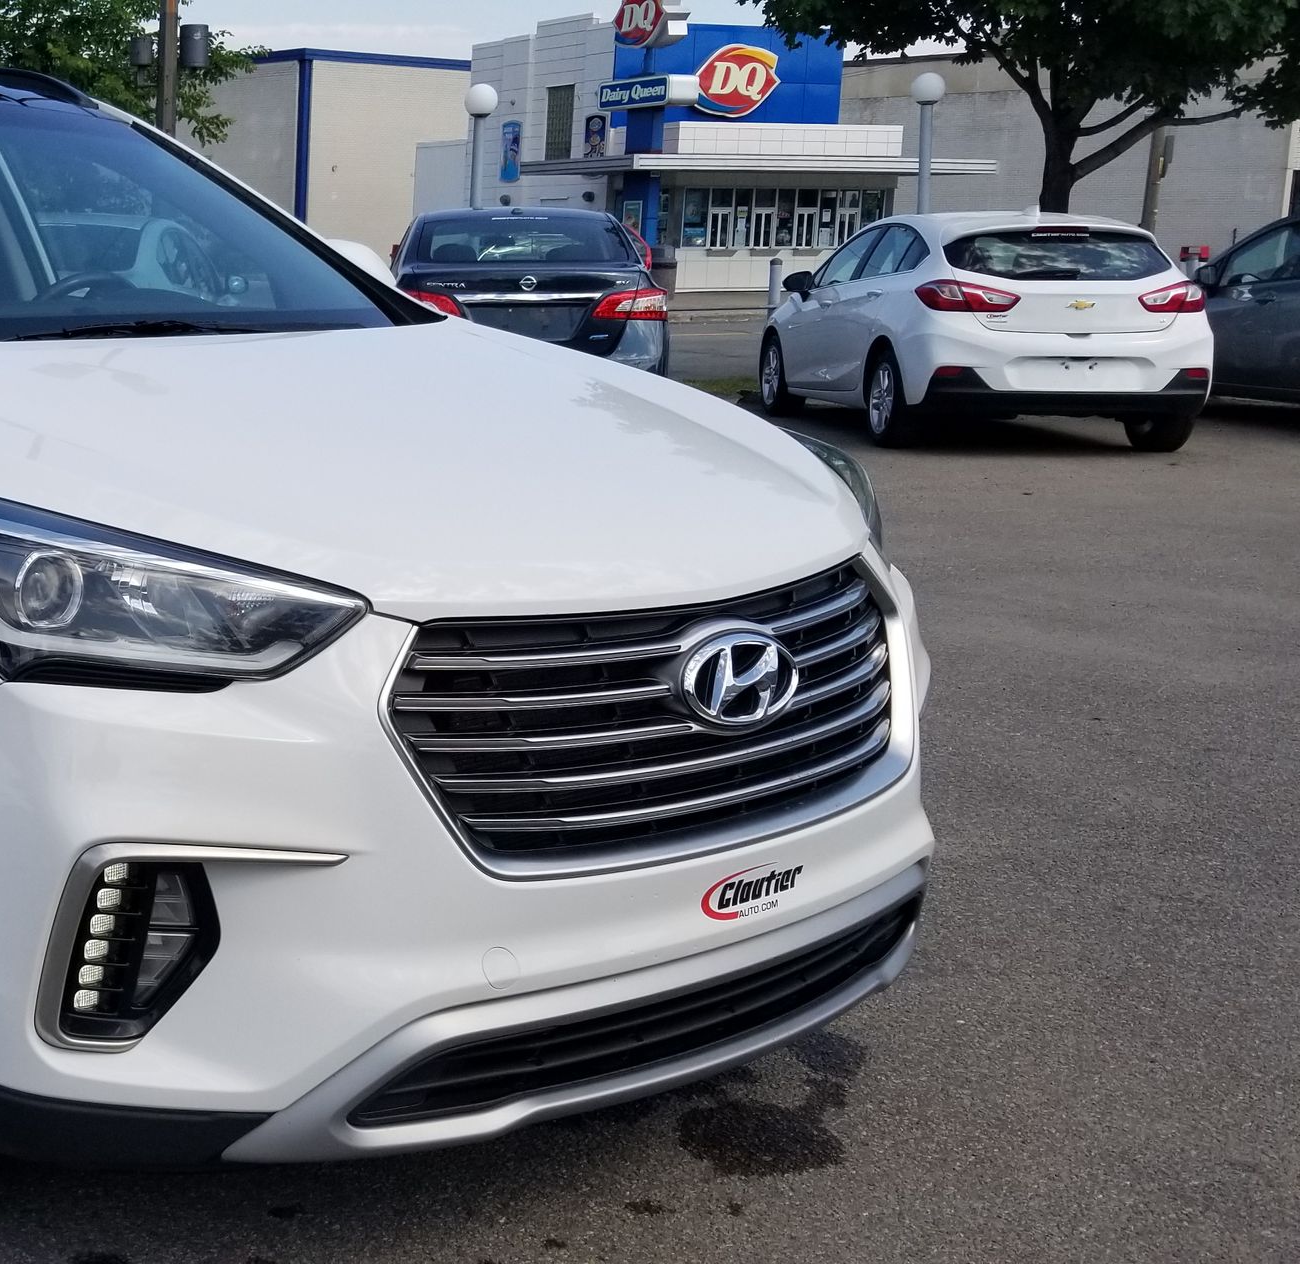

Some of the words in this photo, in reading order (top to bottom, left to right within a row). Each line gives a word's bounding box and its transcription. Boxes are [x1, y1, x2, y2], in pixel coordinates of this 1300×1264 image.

[621, 0, 656, 32] DQ
[601, 87, 630, 104] Dairy
[631, 84, 665, 100] Queen
[708, 61, 767, 100] DQ
[717, 864, 804, 910] Cloutier
